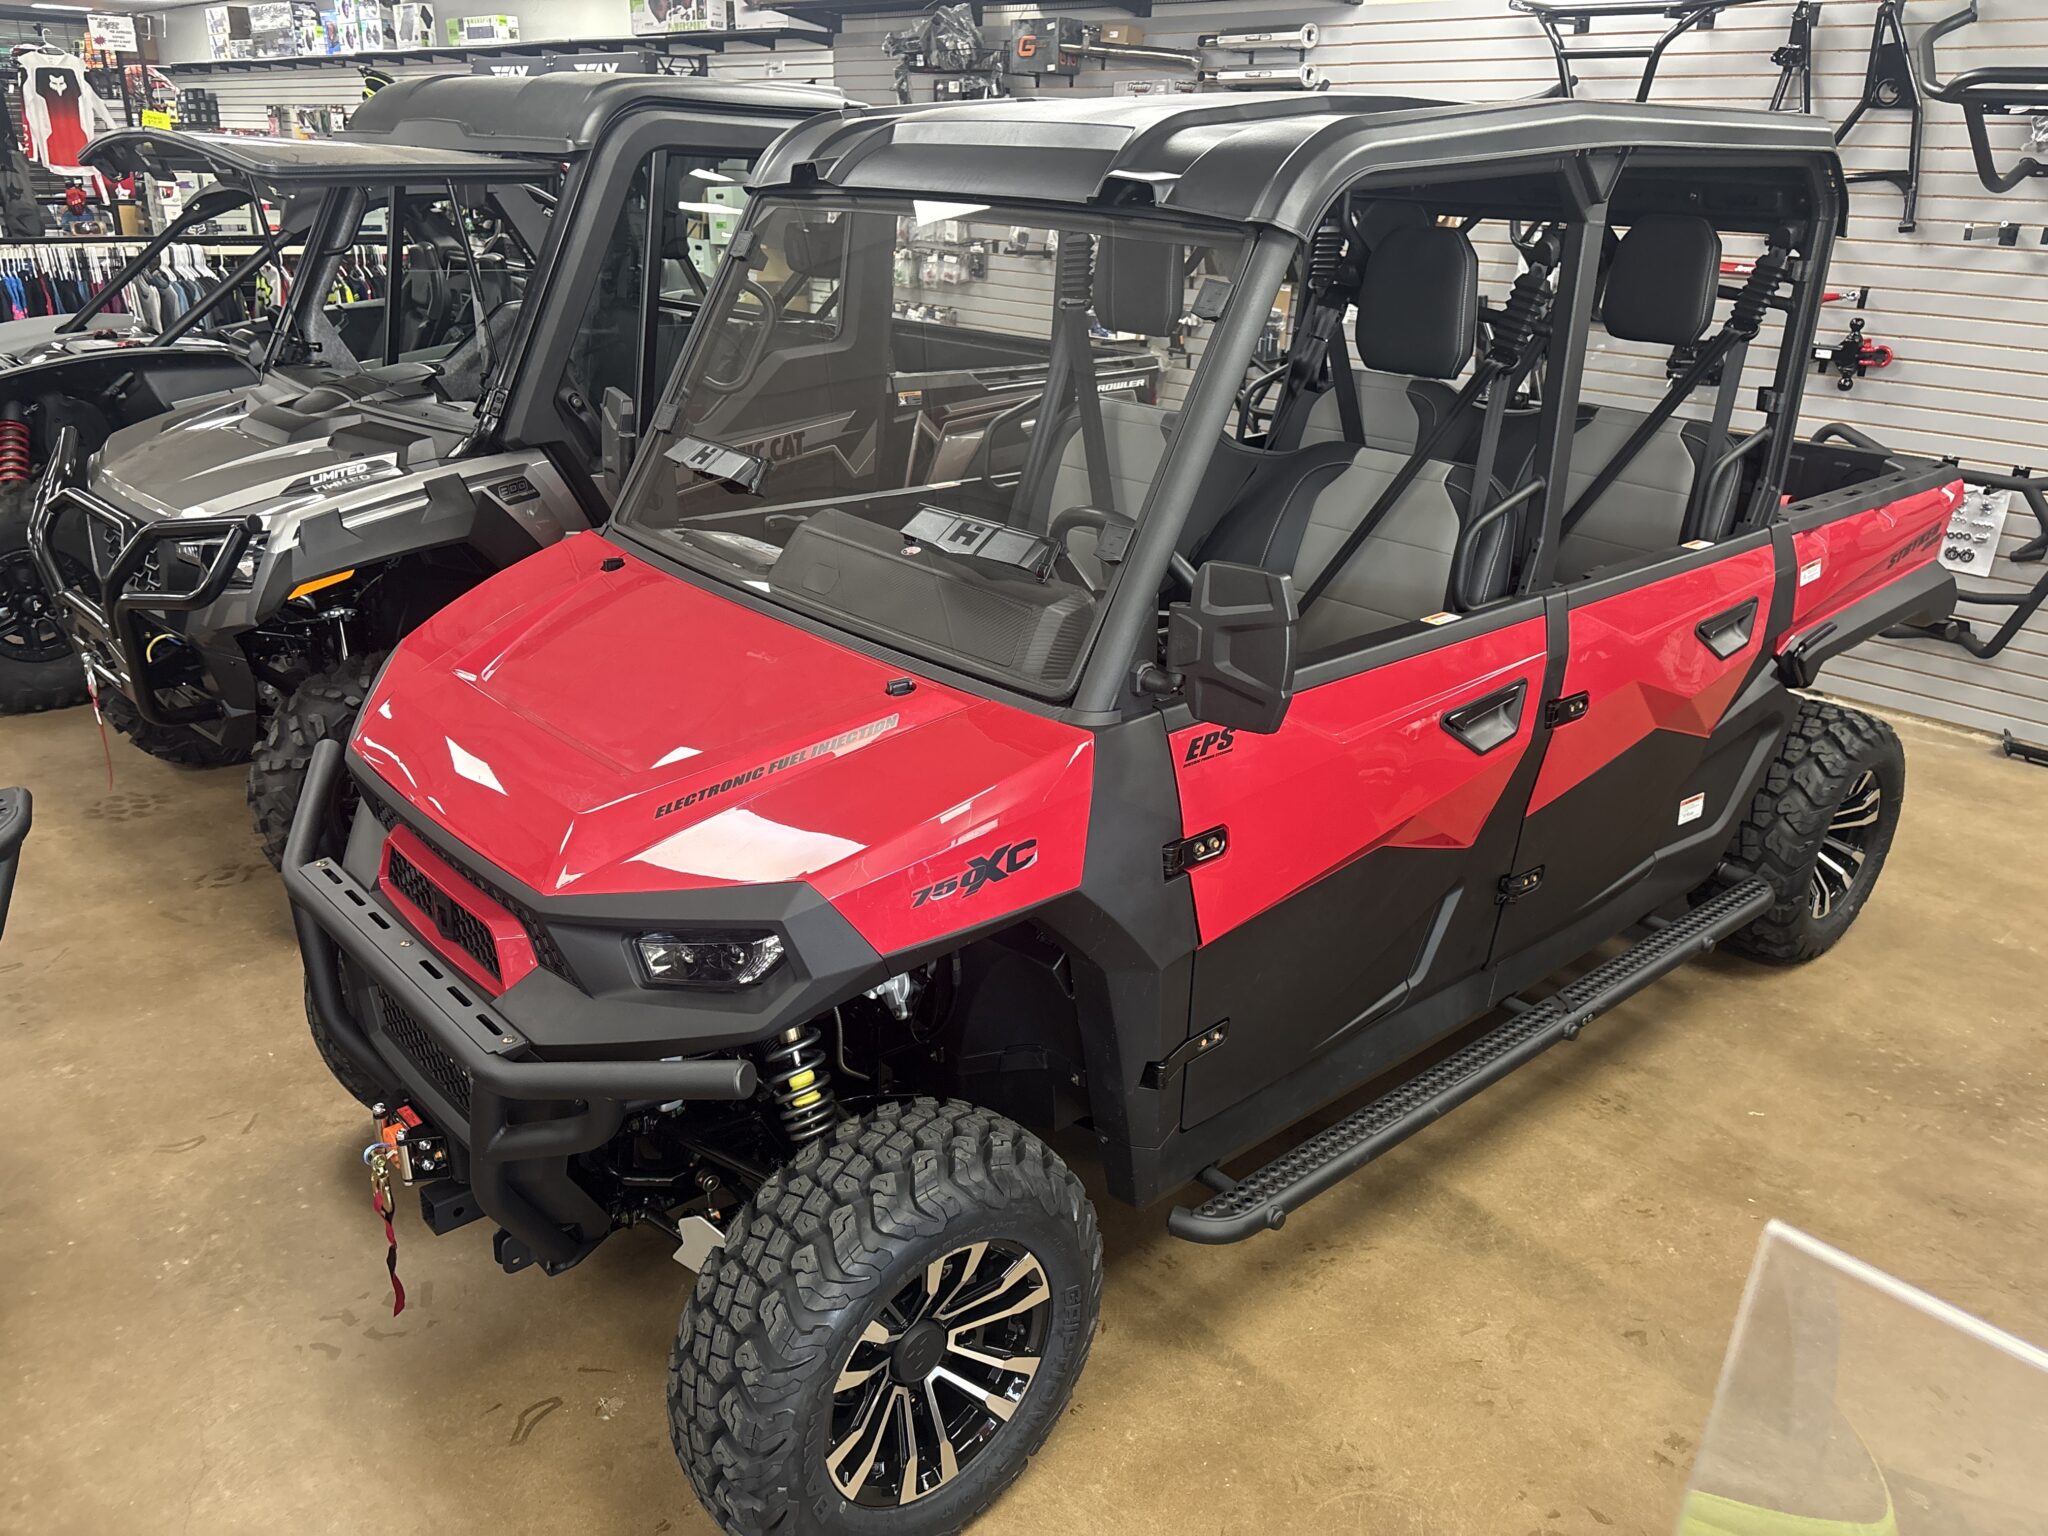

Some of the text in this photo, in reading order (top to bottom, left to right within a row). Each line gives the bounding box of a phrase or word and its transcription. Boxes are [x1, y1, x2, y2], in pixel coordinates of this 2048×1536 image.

[1097, 379, 1145, 392] ROWLER
[770, 431, 805, 461] CAT
[309, 463, 368, 485] LIMITED
[1184, 726, 1236, 762] EPS
[654, 714, 899, 819] ELECTRONIC FUEL INJECTION
